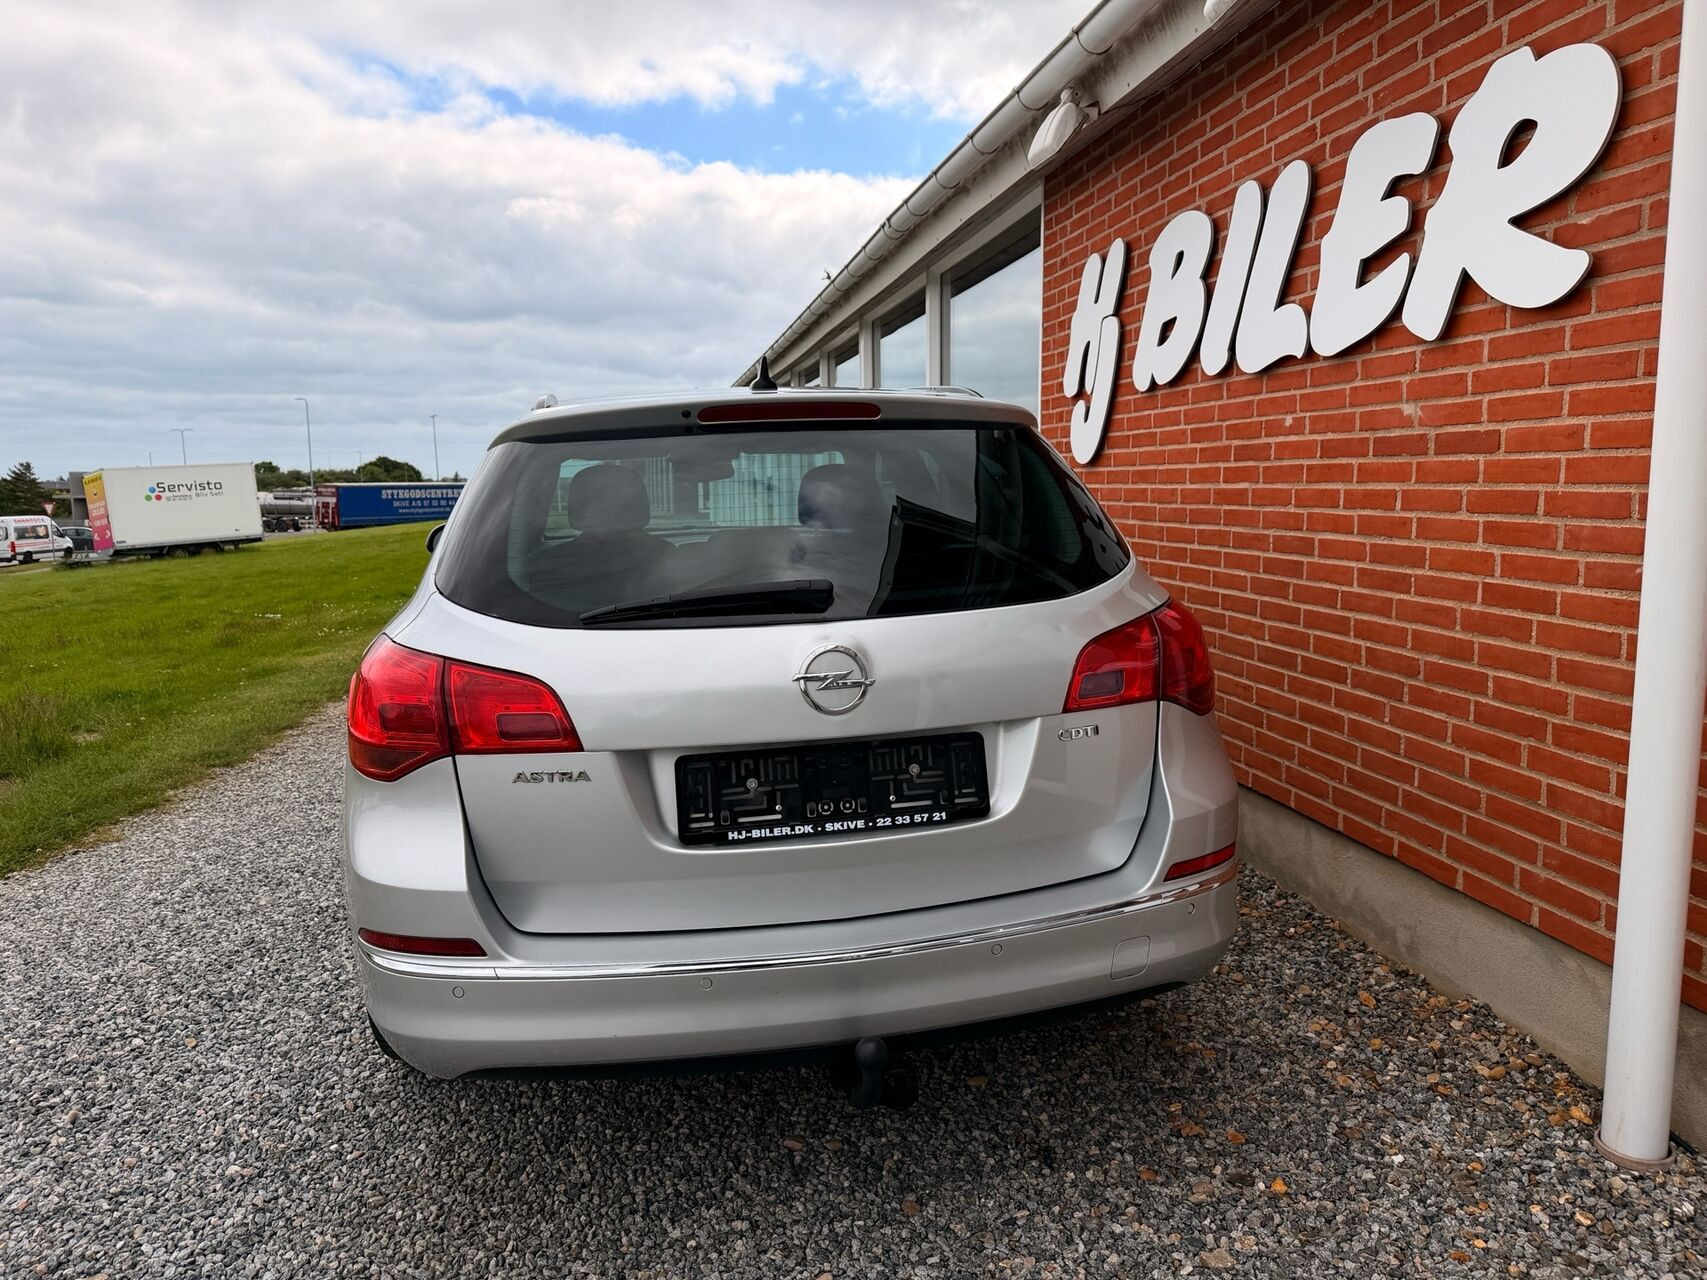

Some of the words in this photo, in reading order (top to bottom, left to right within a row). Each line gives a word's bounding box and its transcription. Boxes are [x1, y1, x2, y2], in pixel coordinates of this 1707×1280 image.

[1132, 42, 1623, 393] BILER
[156, 480, 223, 493] Servisto
[1058, 725, 1100, 741] CDTI
[512, 769, 592, 783] ASTRA
[728, 824, 814, 841] HJ-BILER.DK
[825, 819, 865, 832] SKIVE
[876, 816, 892, 827] 22
[895, 815, 911, 825] 33
[914, 813, 930, 823] 57
[933, 811, 947, 821] 21
